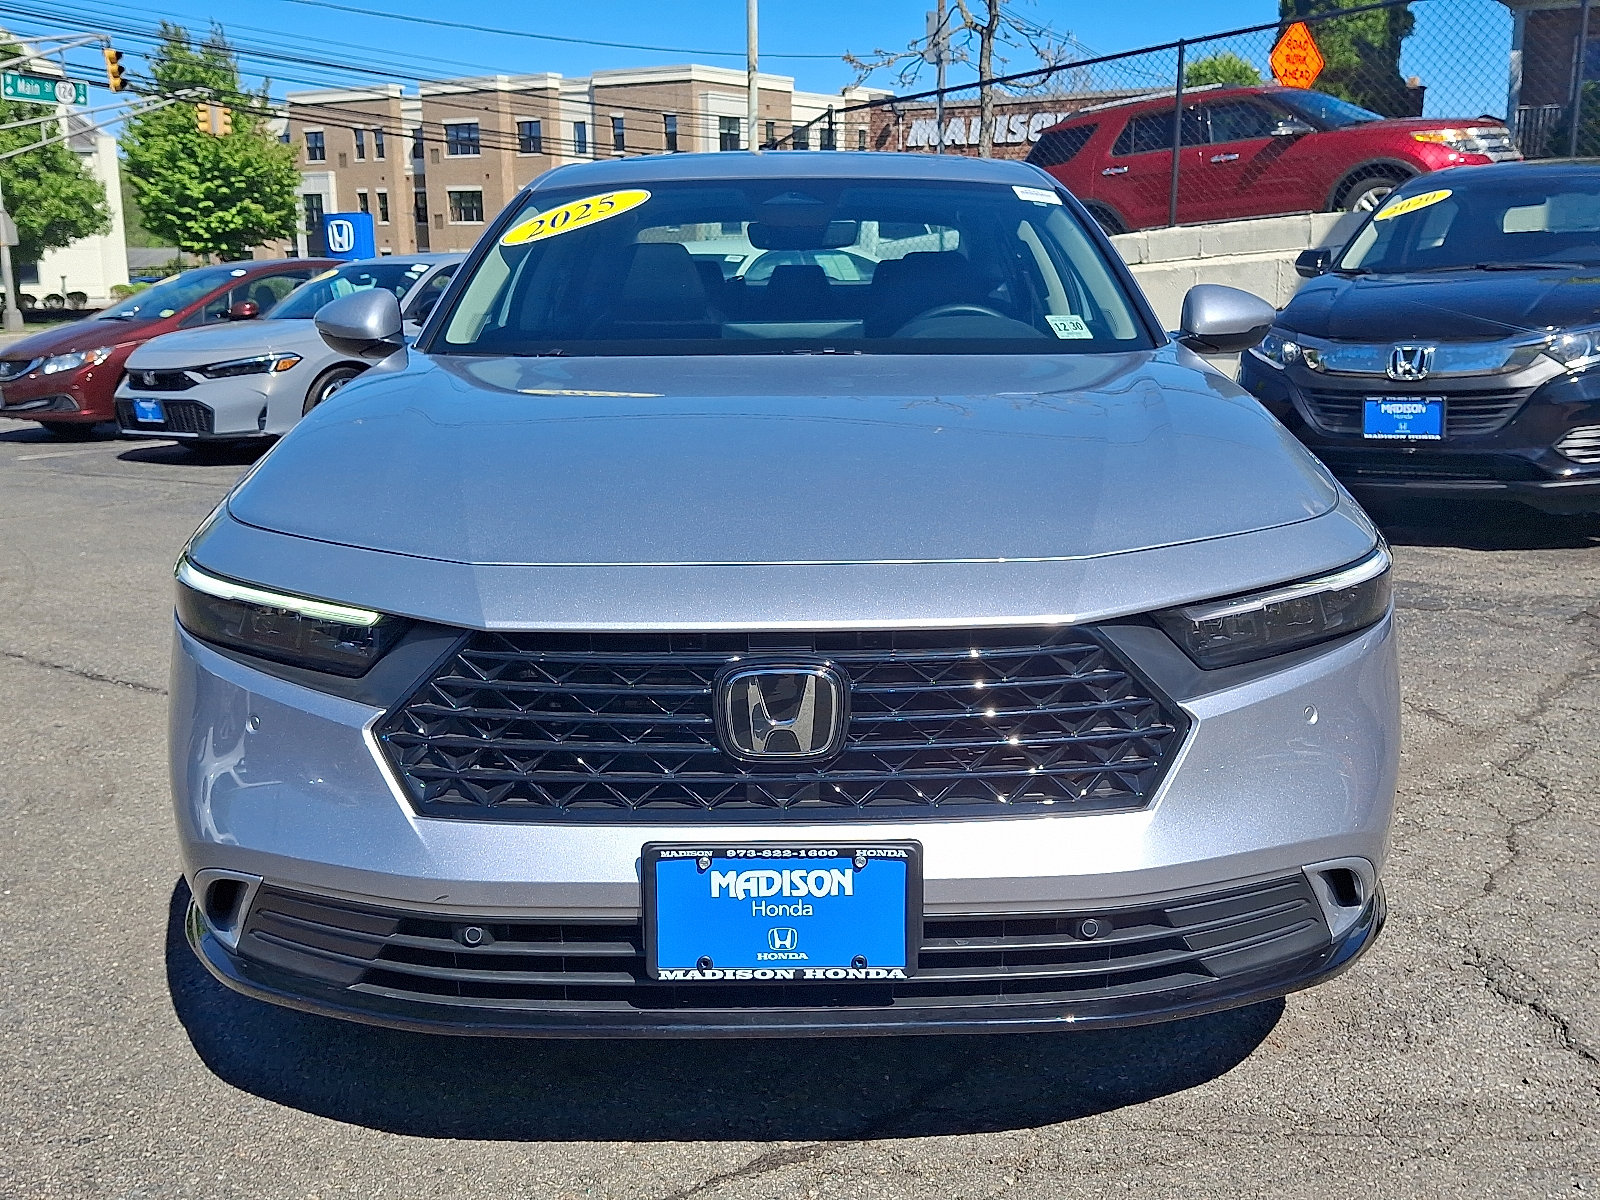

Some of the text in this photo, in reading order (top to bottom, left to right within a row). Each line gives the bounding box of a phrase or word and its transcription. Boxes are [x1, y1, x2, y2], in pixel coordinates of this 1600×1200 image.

[1286, 38, 1309, 51] ROAD
[1282, 68, 1311, 81] AHEAD
[17, 77, 40, 95] Main
[906, 112, 1072, 147] MAISO
[1386, 192, 1437, 214] 2020
[526, 194, 615, 240] 2025
[1054, 321, 1084, 331] 12 30
[1381, 403, 1426, 414] MADISON
[660, 849, 908, 858] MADISON 973-822-1600 HONDA
[710, 868, 854, 900] MADISON
[752, 899, 813, 917] Honda
[757, 952, 809, 961] HONDA
[658, 967, 907, 981] MADISON HONDA
